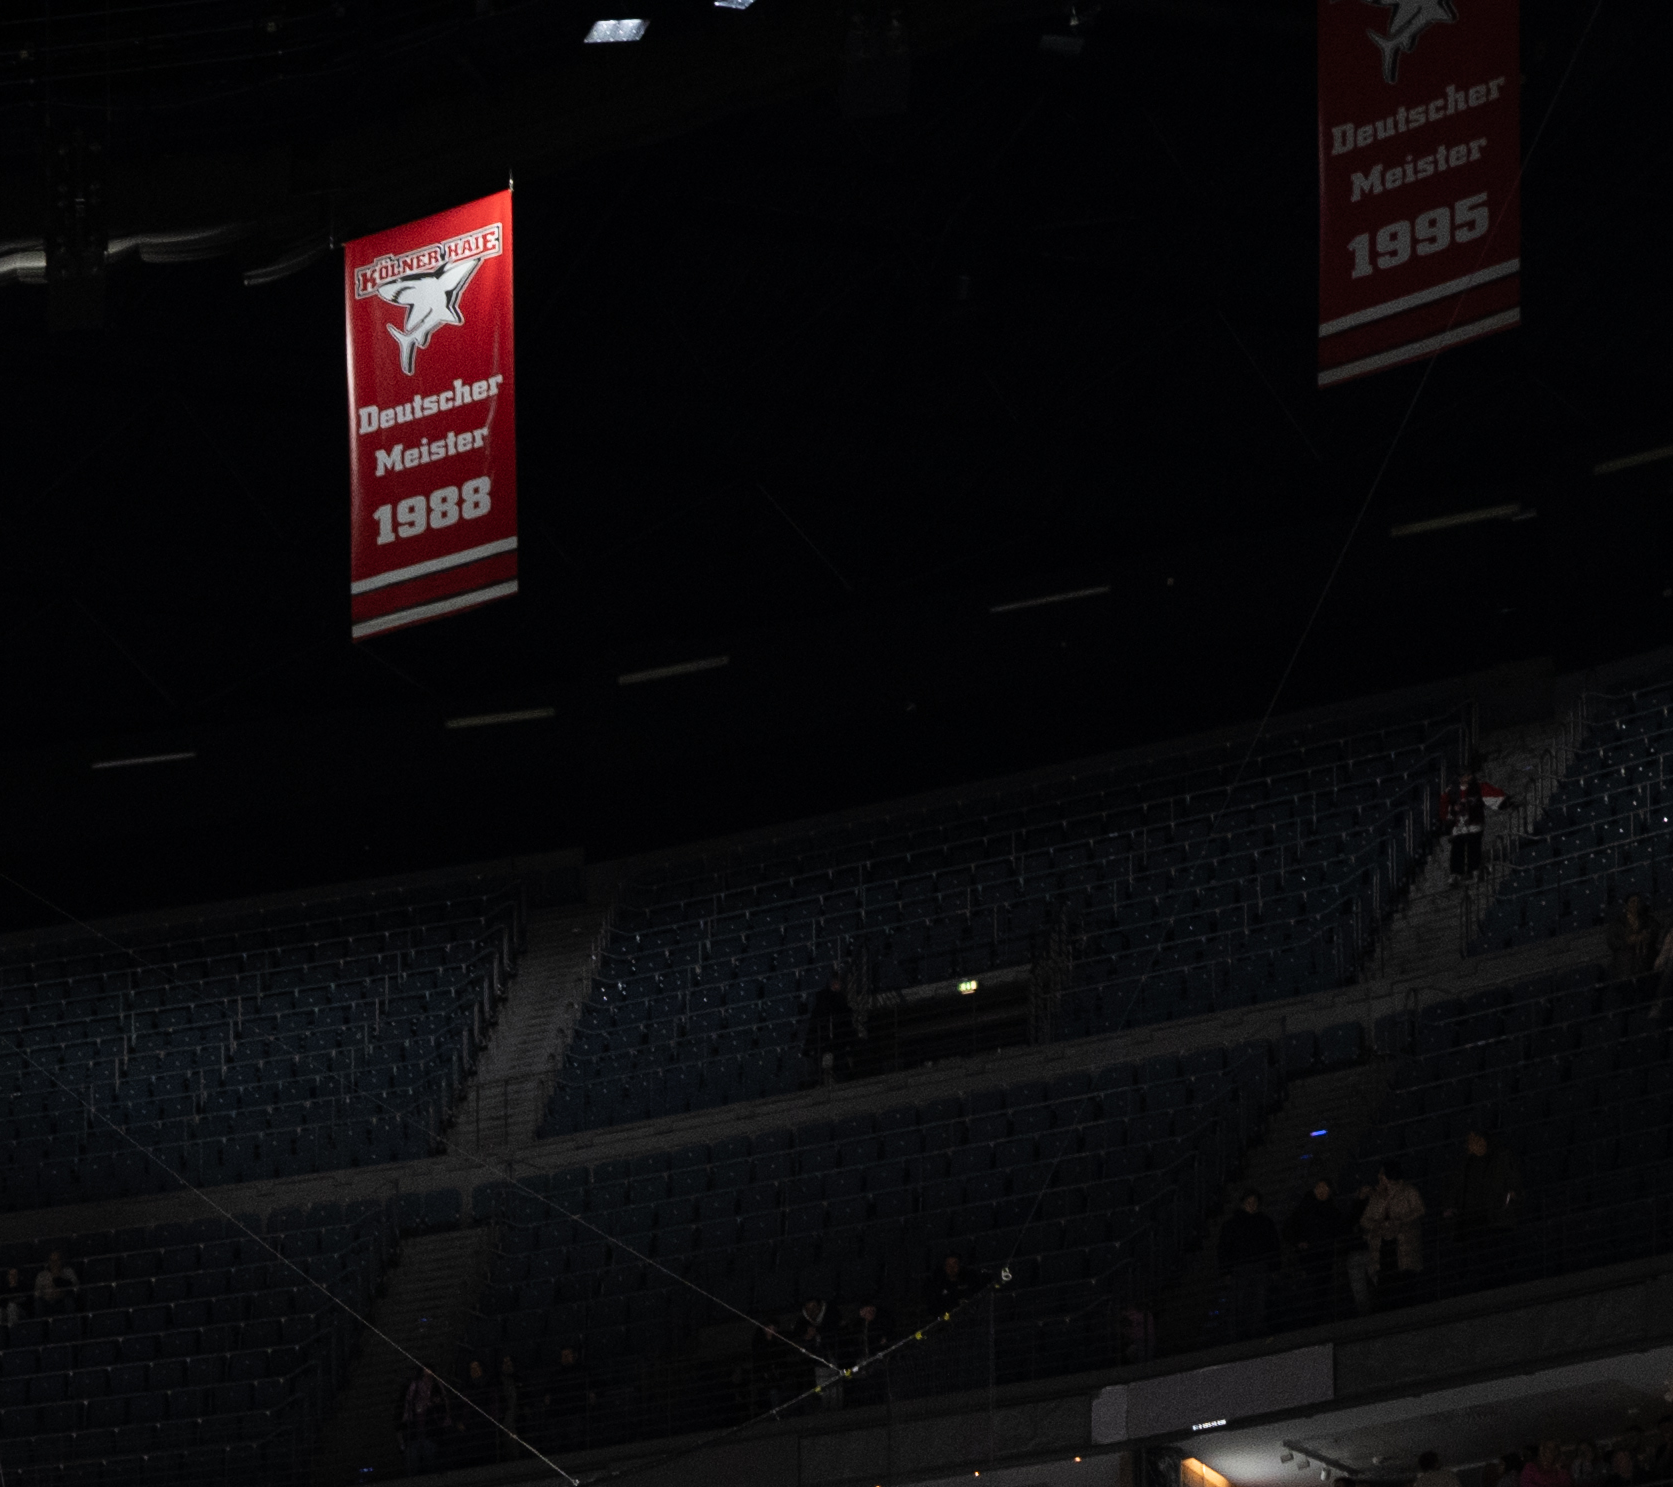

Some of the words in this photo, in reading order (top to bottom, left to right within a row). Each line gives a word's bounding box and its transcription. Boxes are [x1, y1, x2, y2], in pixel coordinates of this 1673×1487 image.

[1331, 76, 1506, 156] Deutscher
[1350, 137, 1488, 202] Meister
[361, 249, 442, 294] KÖLNER
[447, 232, 500, 263] HAIE
[1346, 191, 1490, 279] 1995
[359, 374, 503, 434] Deutscher
[375, 425, 489, 477] Meister
[372, 476, 492, 546] 1988
